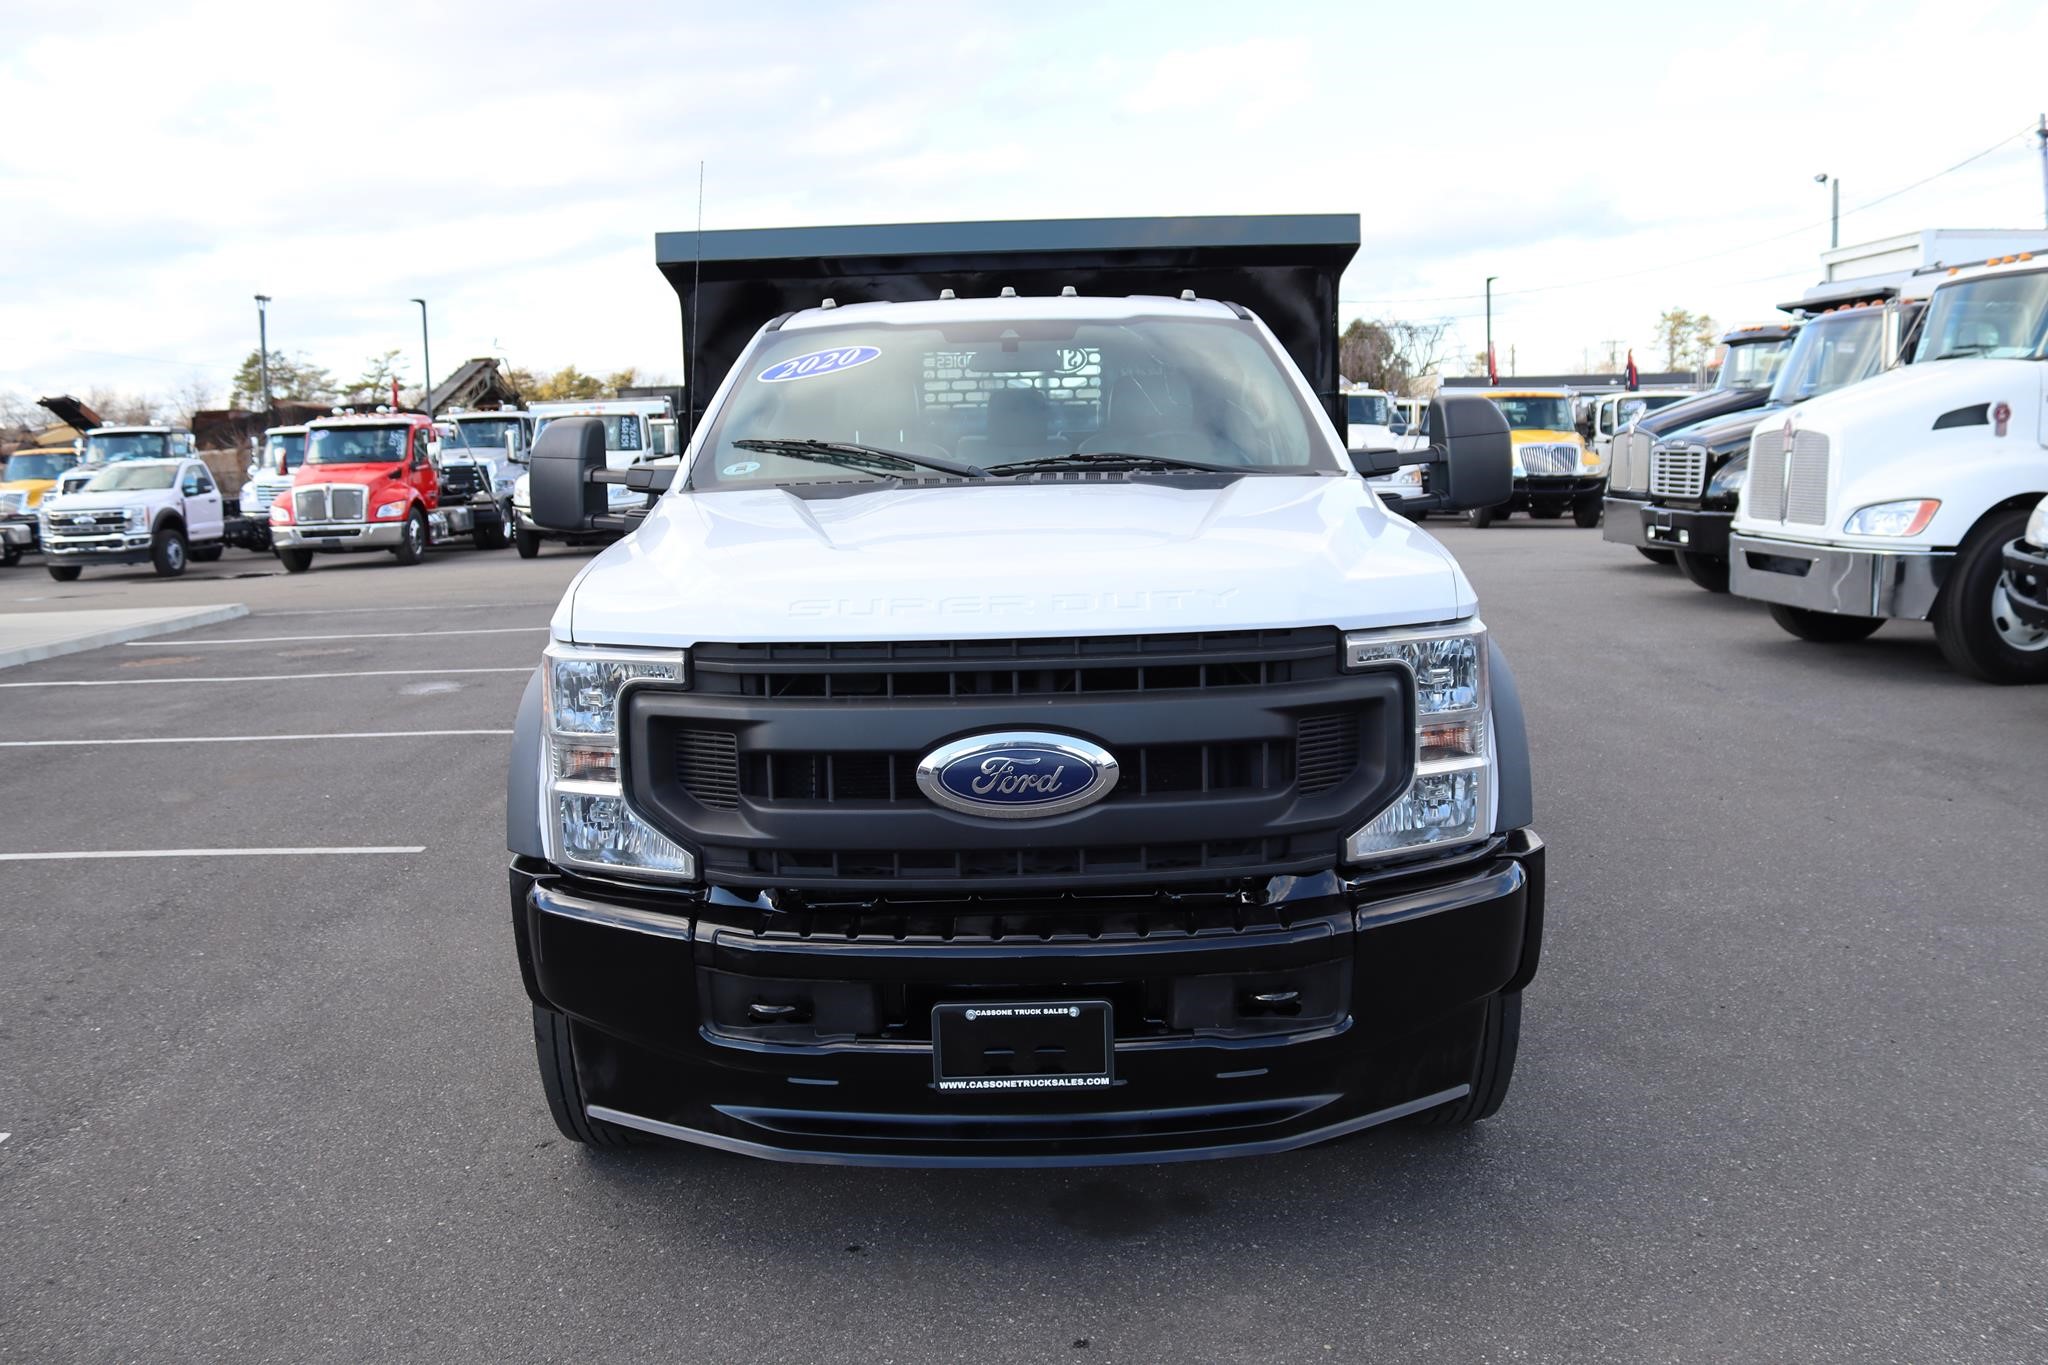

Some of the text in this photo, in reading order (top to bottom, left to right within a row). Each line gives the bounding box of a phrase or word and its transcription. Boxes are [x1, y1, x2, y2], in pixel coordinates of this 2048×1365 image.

[774, 347, 861, 380] 2020
[786, 586, 1240, 620] SUPER DUTY
[971, 756, 1065, 795] Ford
[1014, 1008, 1041, 1016] TRUCK
[1043, 1007, 1069, 1015] SALES
[939, 1077, 1110, 1089] WWW.CASSONETRUCKSALES.COM
